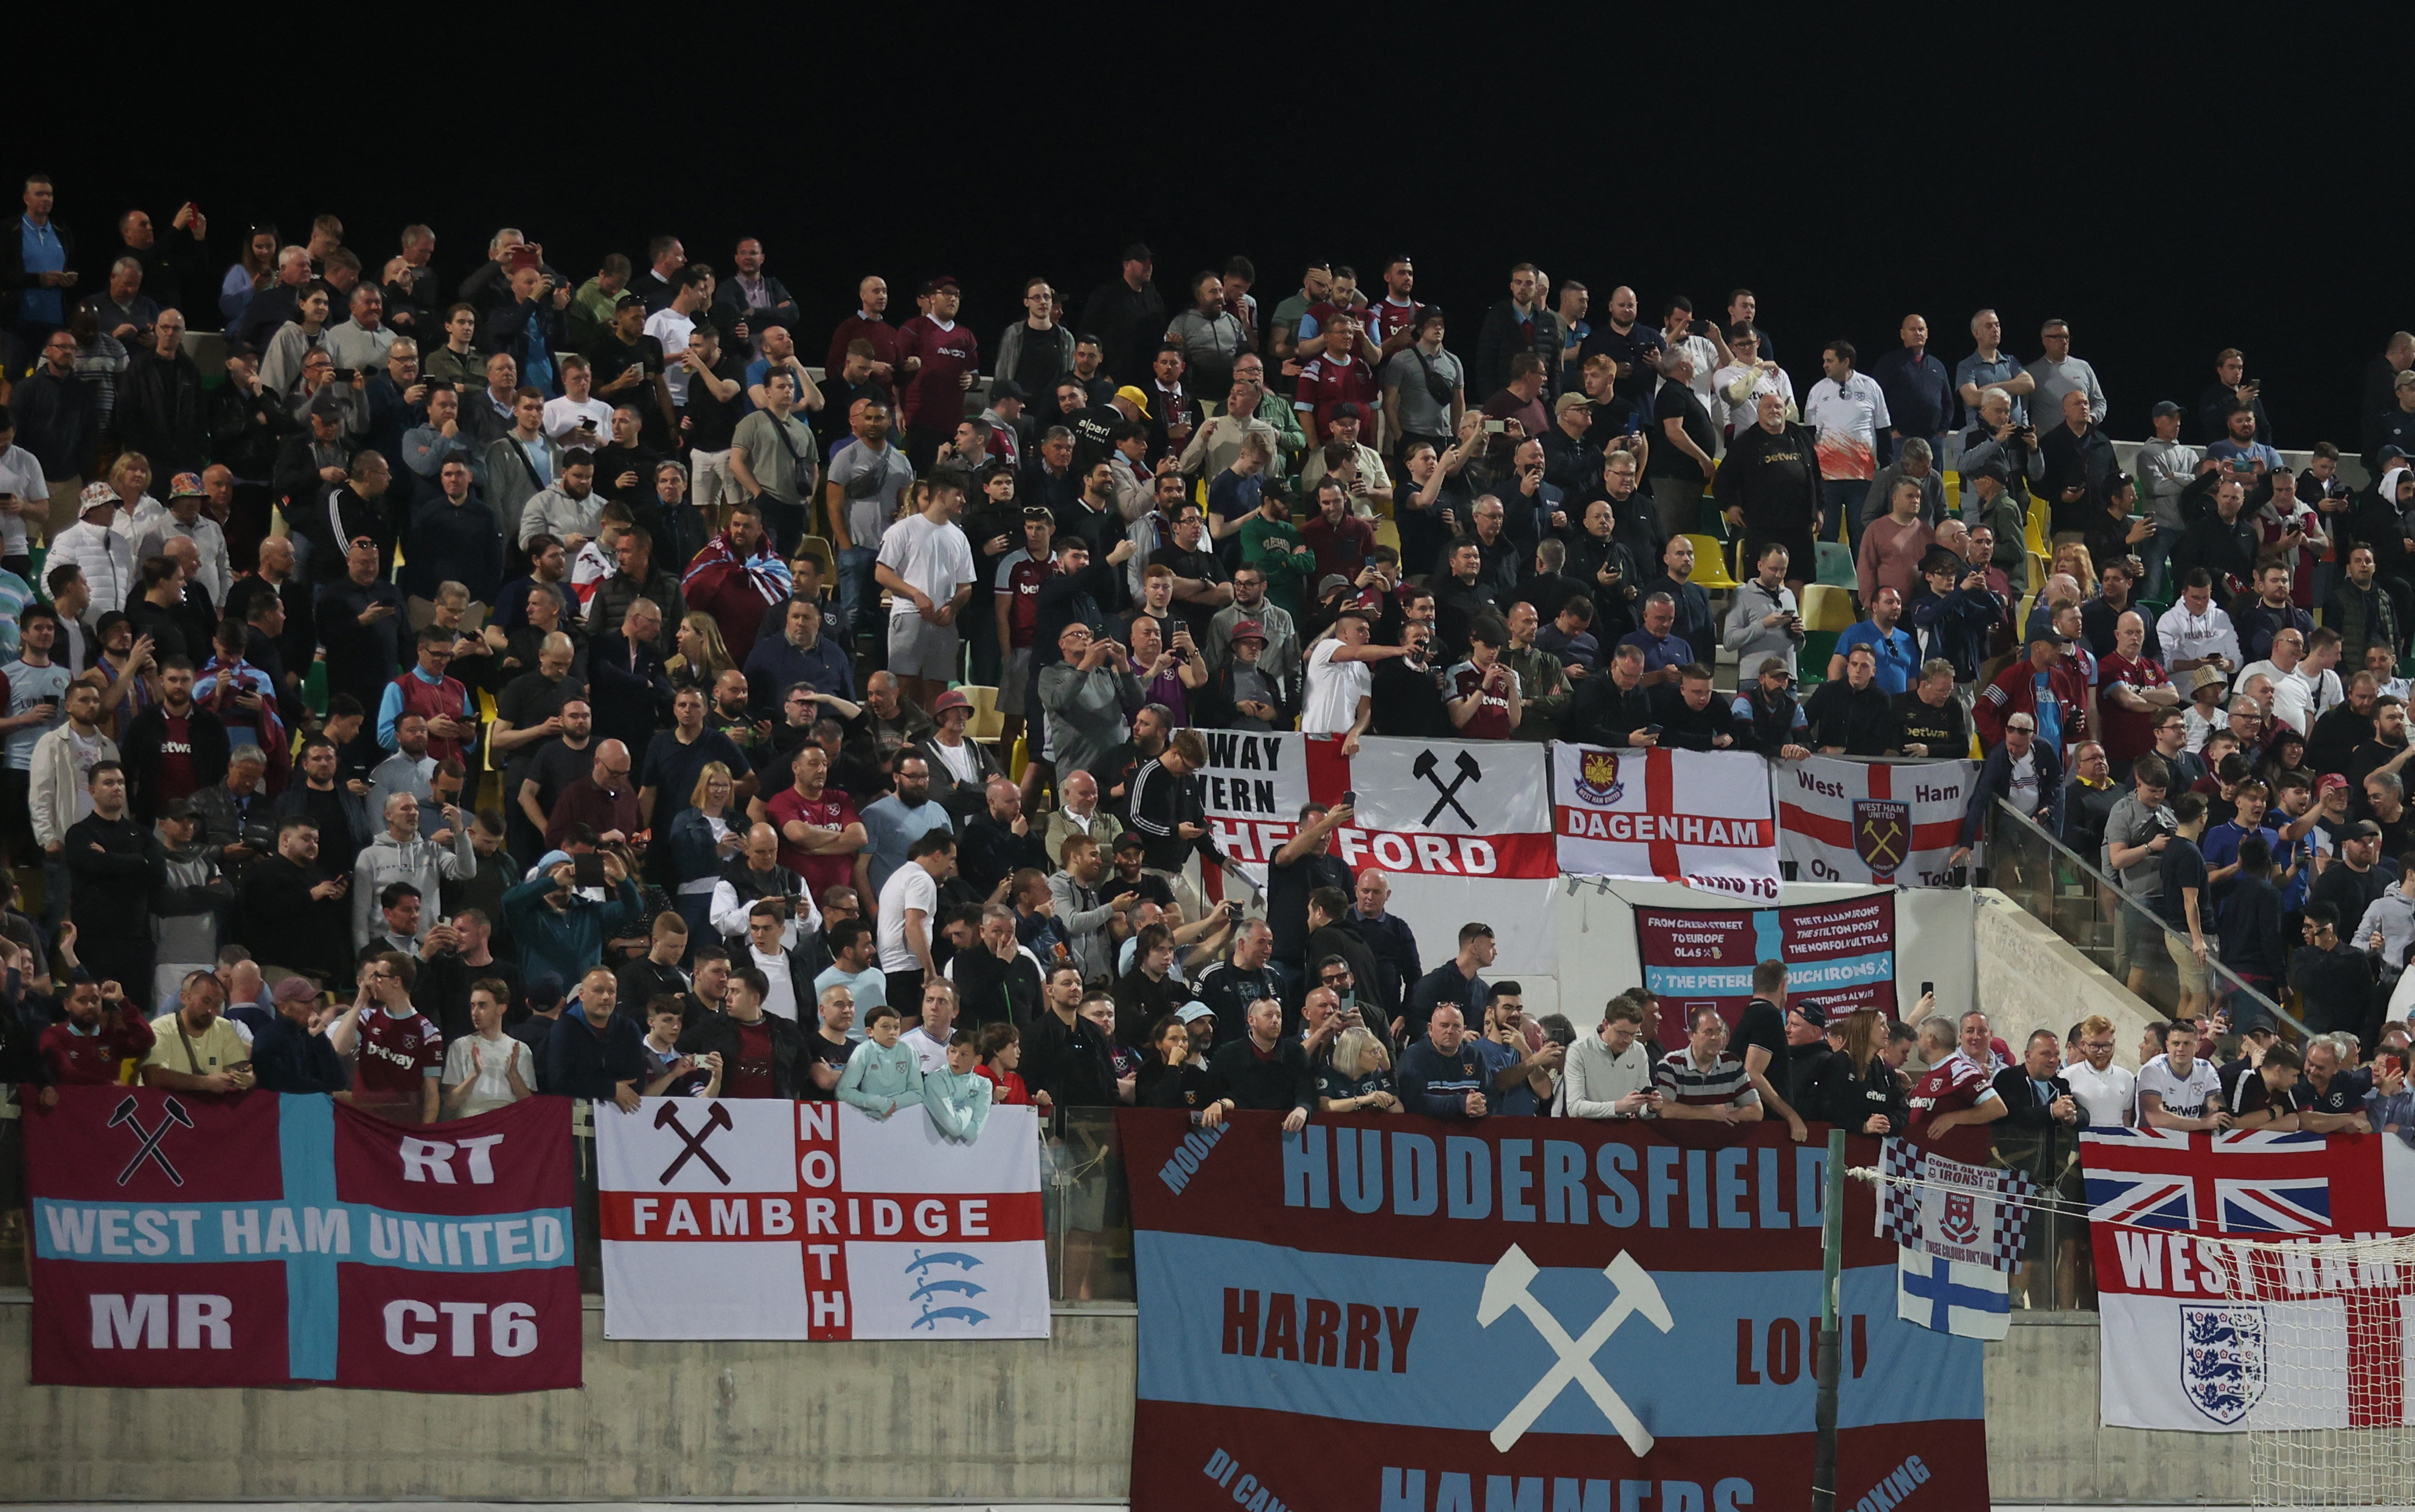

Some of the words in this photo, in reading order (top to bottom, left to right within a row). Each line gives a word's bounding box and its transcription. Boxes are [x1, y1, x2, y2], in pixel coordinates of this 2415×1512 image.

[1079, 418, 1111, 437] alpari
[1207, 732, 1282, 771] WAY
[1579, 788, 1592, 801] WEST
[1604, 791, 1621, 803] UNITED
[1796, 769, 1844, 799] West
[1916, 785, 1959, 803] Ham
[1858, 803, 1882, 812] WEST
[1883, 805, 1905, 814] HAM
[1868, 811, 1896, 820] UNITED
[1568, 808, 1759, 845] DAGENHAM
[1811, 859, 1840, 882] On
[1918, 871, 1954, 886] Tou
[1873, 862, 1894, 871] LONDON
[1749, 877, 1778, 899] FC
[1648, 917, 1676, 929] FROM
[1708, 921, 1743, 930] STREET
[1793, 916, 1813, 926] THE
[1796, 930, 1813, 939] THE
[1813, 924, 1852, 938] STILTON
[1672, 933, 1686, 943] TO
[1686, 934, 1725, 943] EUROPE
[1788, 943, 1810, 954] THE
[1851, 932, 1889, 947] ULTRAS
[1674, 947, 1702, 957] OLAS
[1666, 975, 1695, 988] THE
[1824, 962, 1875, 980] IRONS
[1849, 989, 1874, 1001] ALWAYS
[367, 1041, 415, 1070] betway
[1906, 1096, 1936, 1111] etway
[399, 1133, 504, 1184] RT
[1928, 1157, 1958, 1171] COME
[1282, 1124, 1829, 1230] HUDDERSFIELD
[1939, 1168, 1983, 1187] IRONS!
[1950, 1194, 1970, 1204] IRONS
[633, 1197, 990, 1236] FAMBRIDGE
[801, 1103, 845, 1327] NORTH
[44, 1204, 201, 1256] WEST
[223, 1207, 351, 1255] HAM
[369, 1212, 565, 1266] UNITED
[1925, 1240, 1942, 1256] THESE
[1942, 1244, 1965, 1262] COLOURS
[2113, 1230, 2257, 1295] WEST
[2279, 1232, 2399, 1295] HAM
[89, 1294, 233, 1350] MR
[383, 1299, 538, 1358] CT6
[1220, 1286, 1420, 1374] HARRY
[1203, 1447, 1240, 1488] DI
